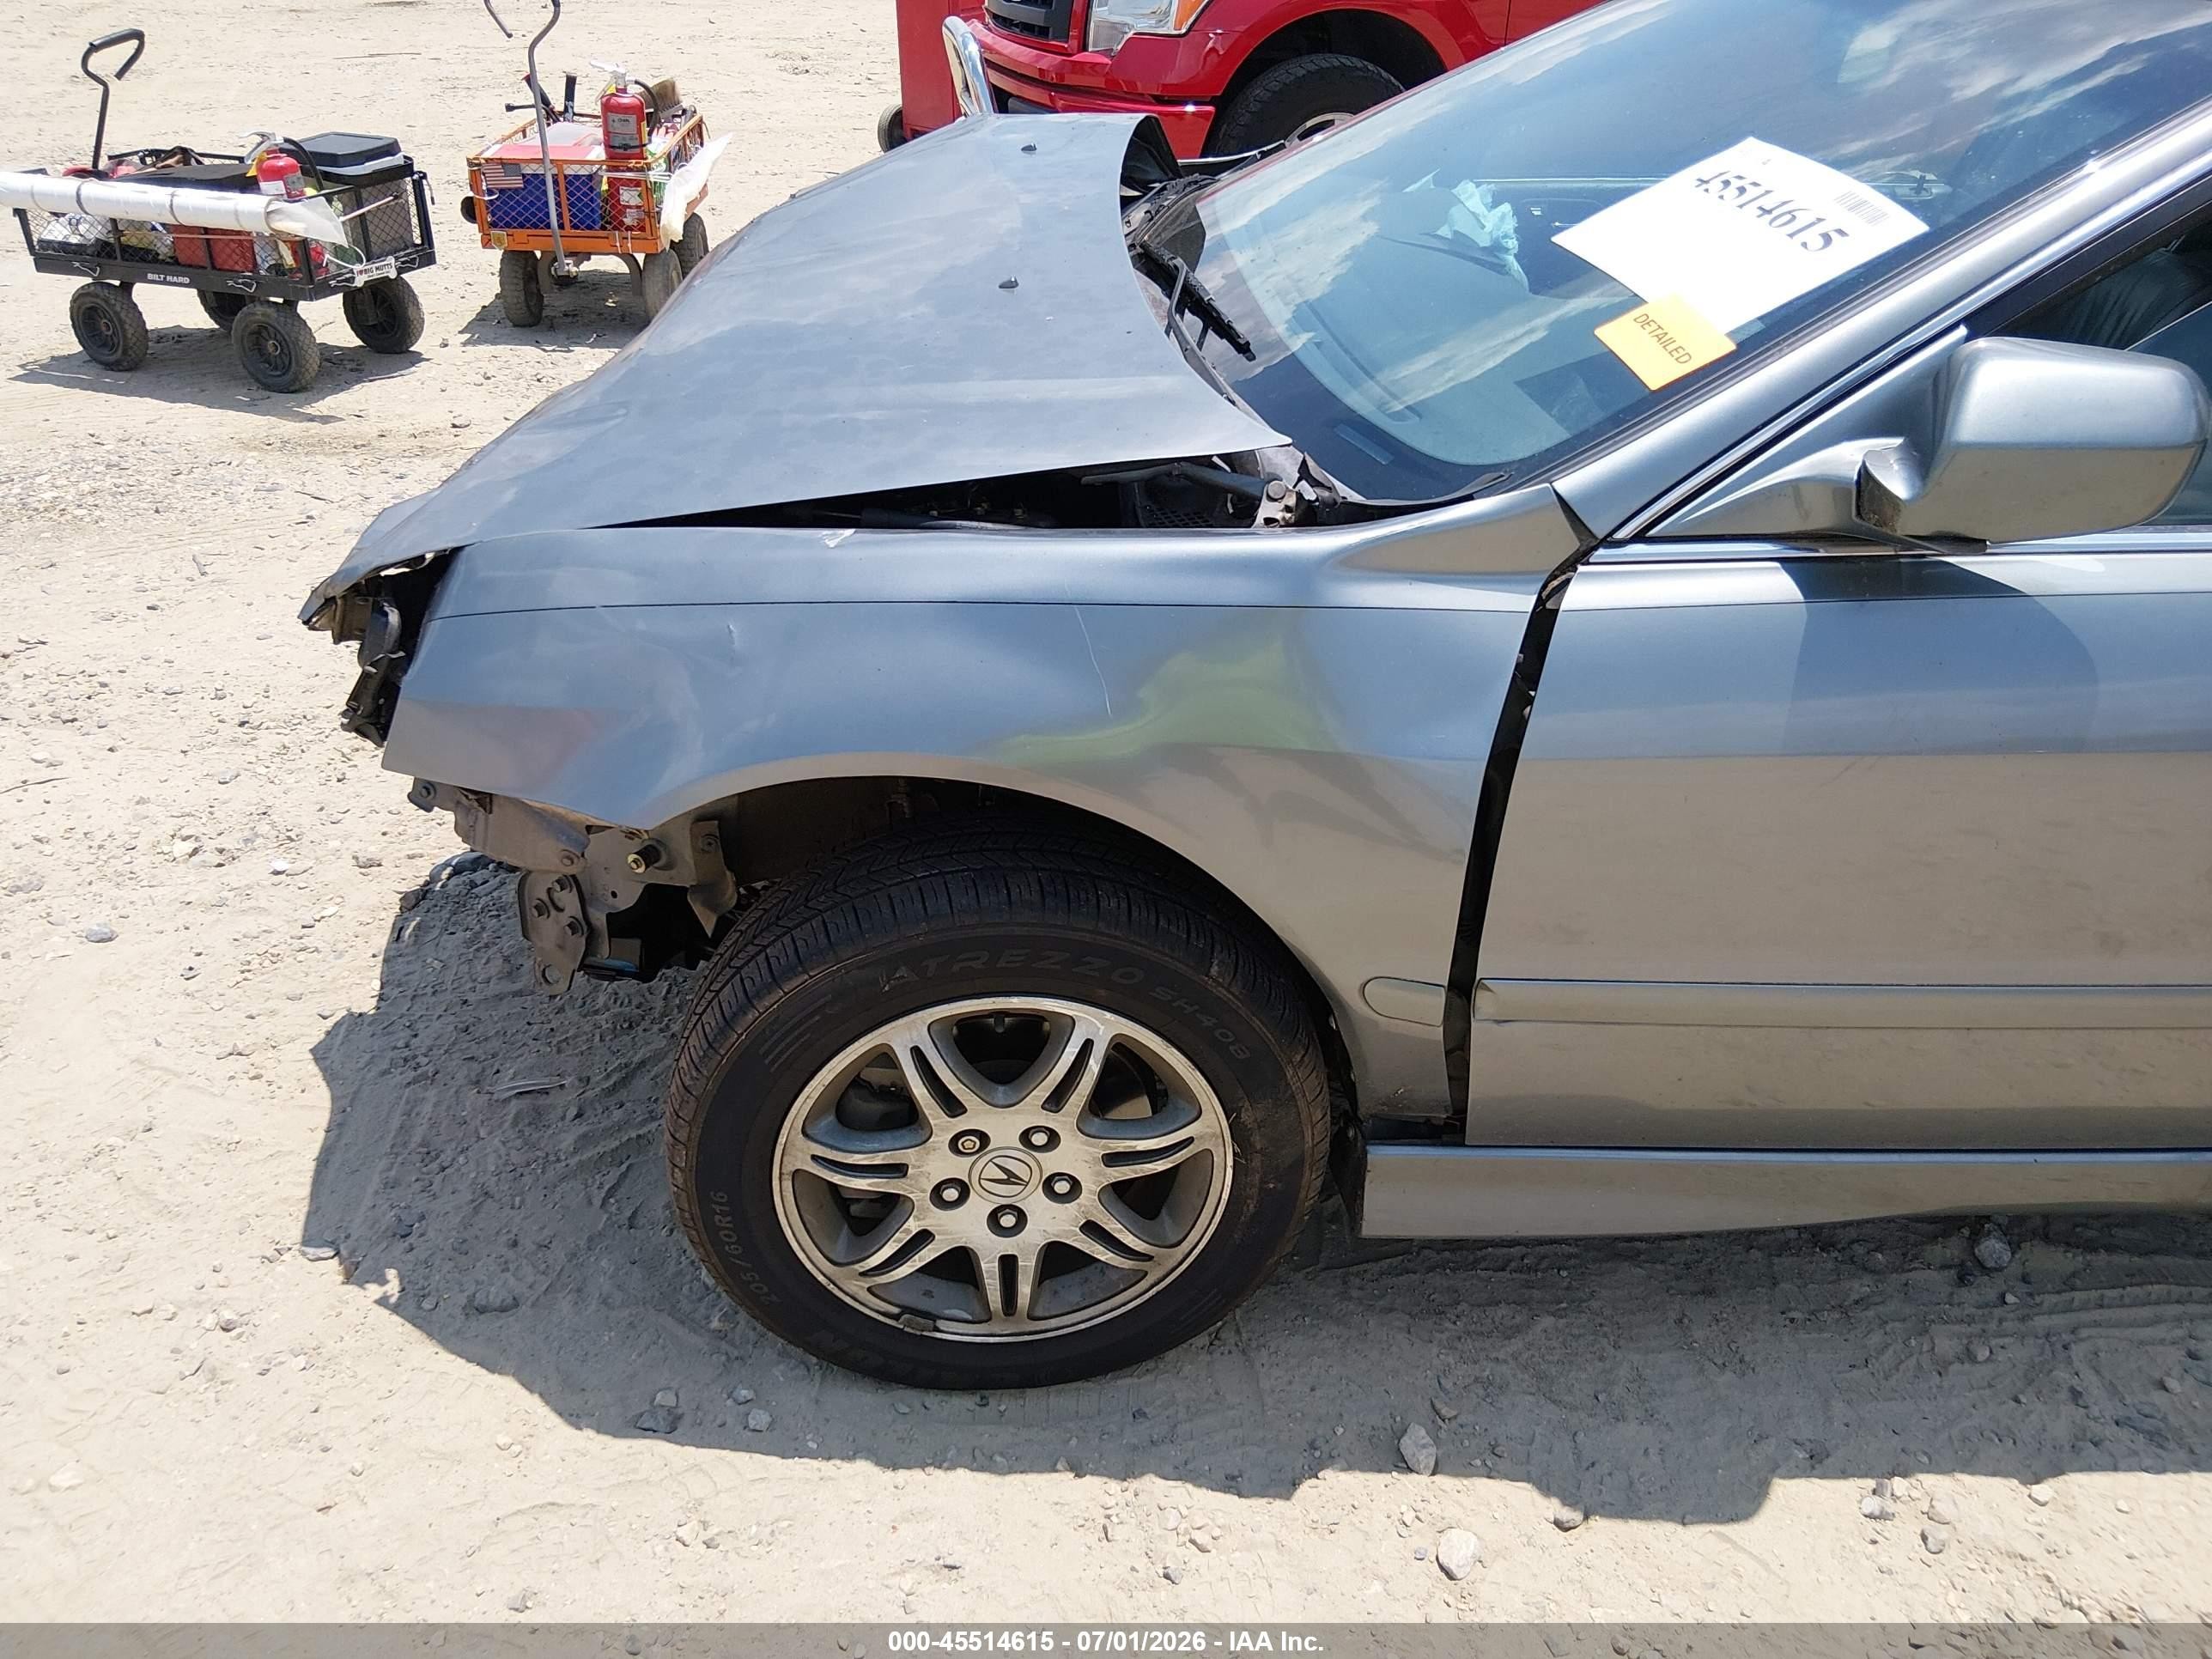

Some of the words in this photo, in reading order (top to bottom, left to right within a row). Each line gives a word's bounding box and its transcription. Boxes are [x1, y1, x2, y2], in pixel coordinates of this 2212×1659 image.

[1695, 170, 1849, 252] 45514615
[147, 273, 165, 282] BILT
[167, 275, 190, 284] HARD
[1633, 313, 1692, 365] DETAILED
[883, 950, 1145, 989] ATREZZO
[1151, 986, 1251, 1060] SH408
